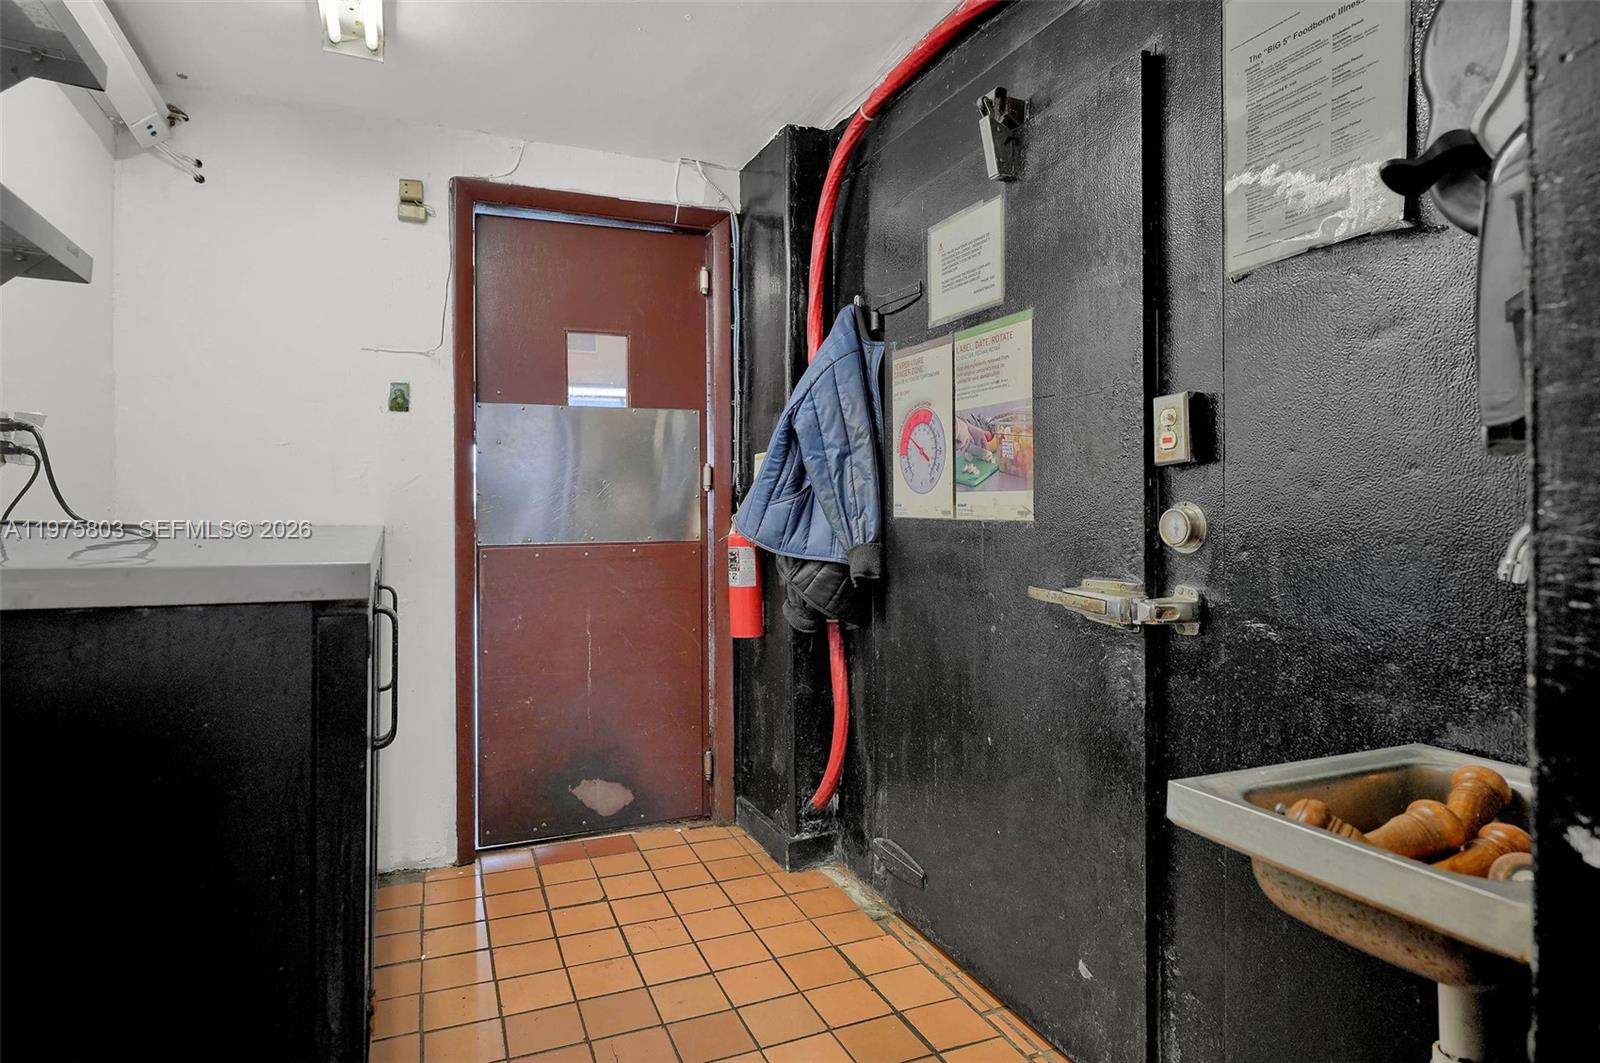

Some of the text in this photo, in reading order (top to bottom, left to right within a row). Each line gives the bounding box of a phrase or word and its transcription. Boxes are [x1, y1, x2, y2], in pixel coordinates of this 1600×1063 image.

[1249, 53, 1262, 63] The
[1293, 12, 1336, 40] Foodborne
[991, 330, 1015, 345] ROTATE
